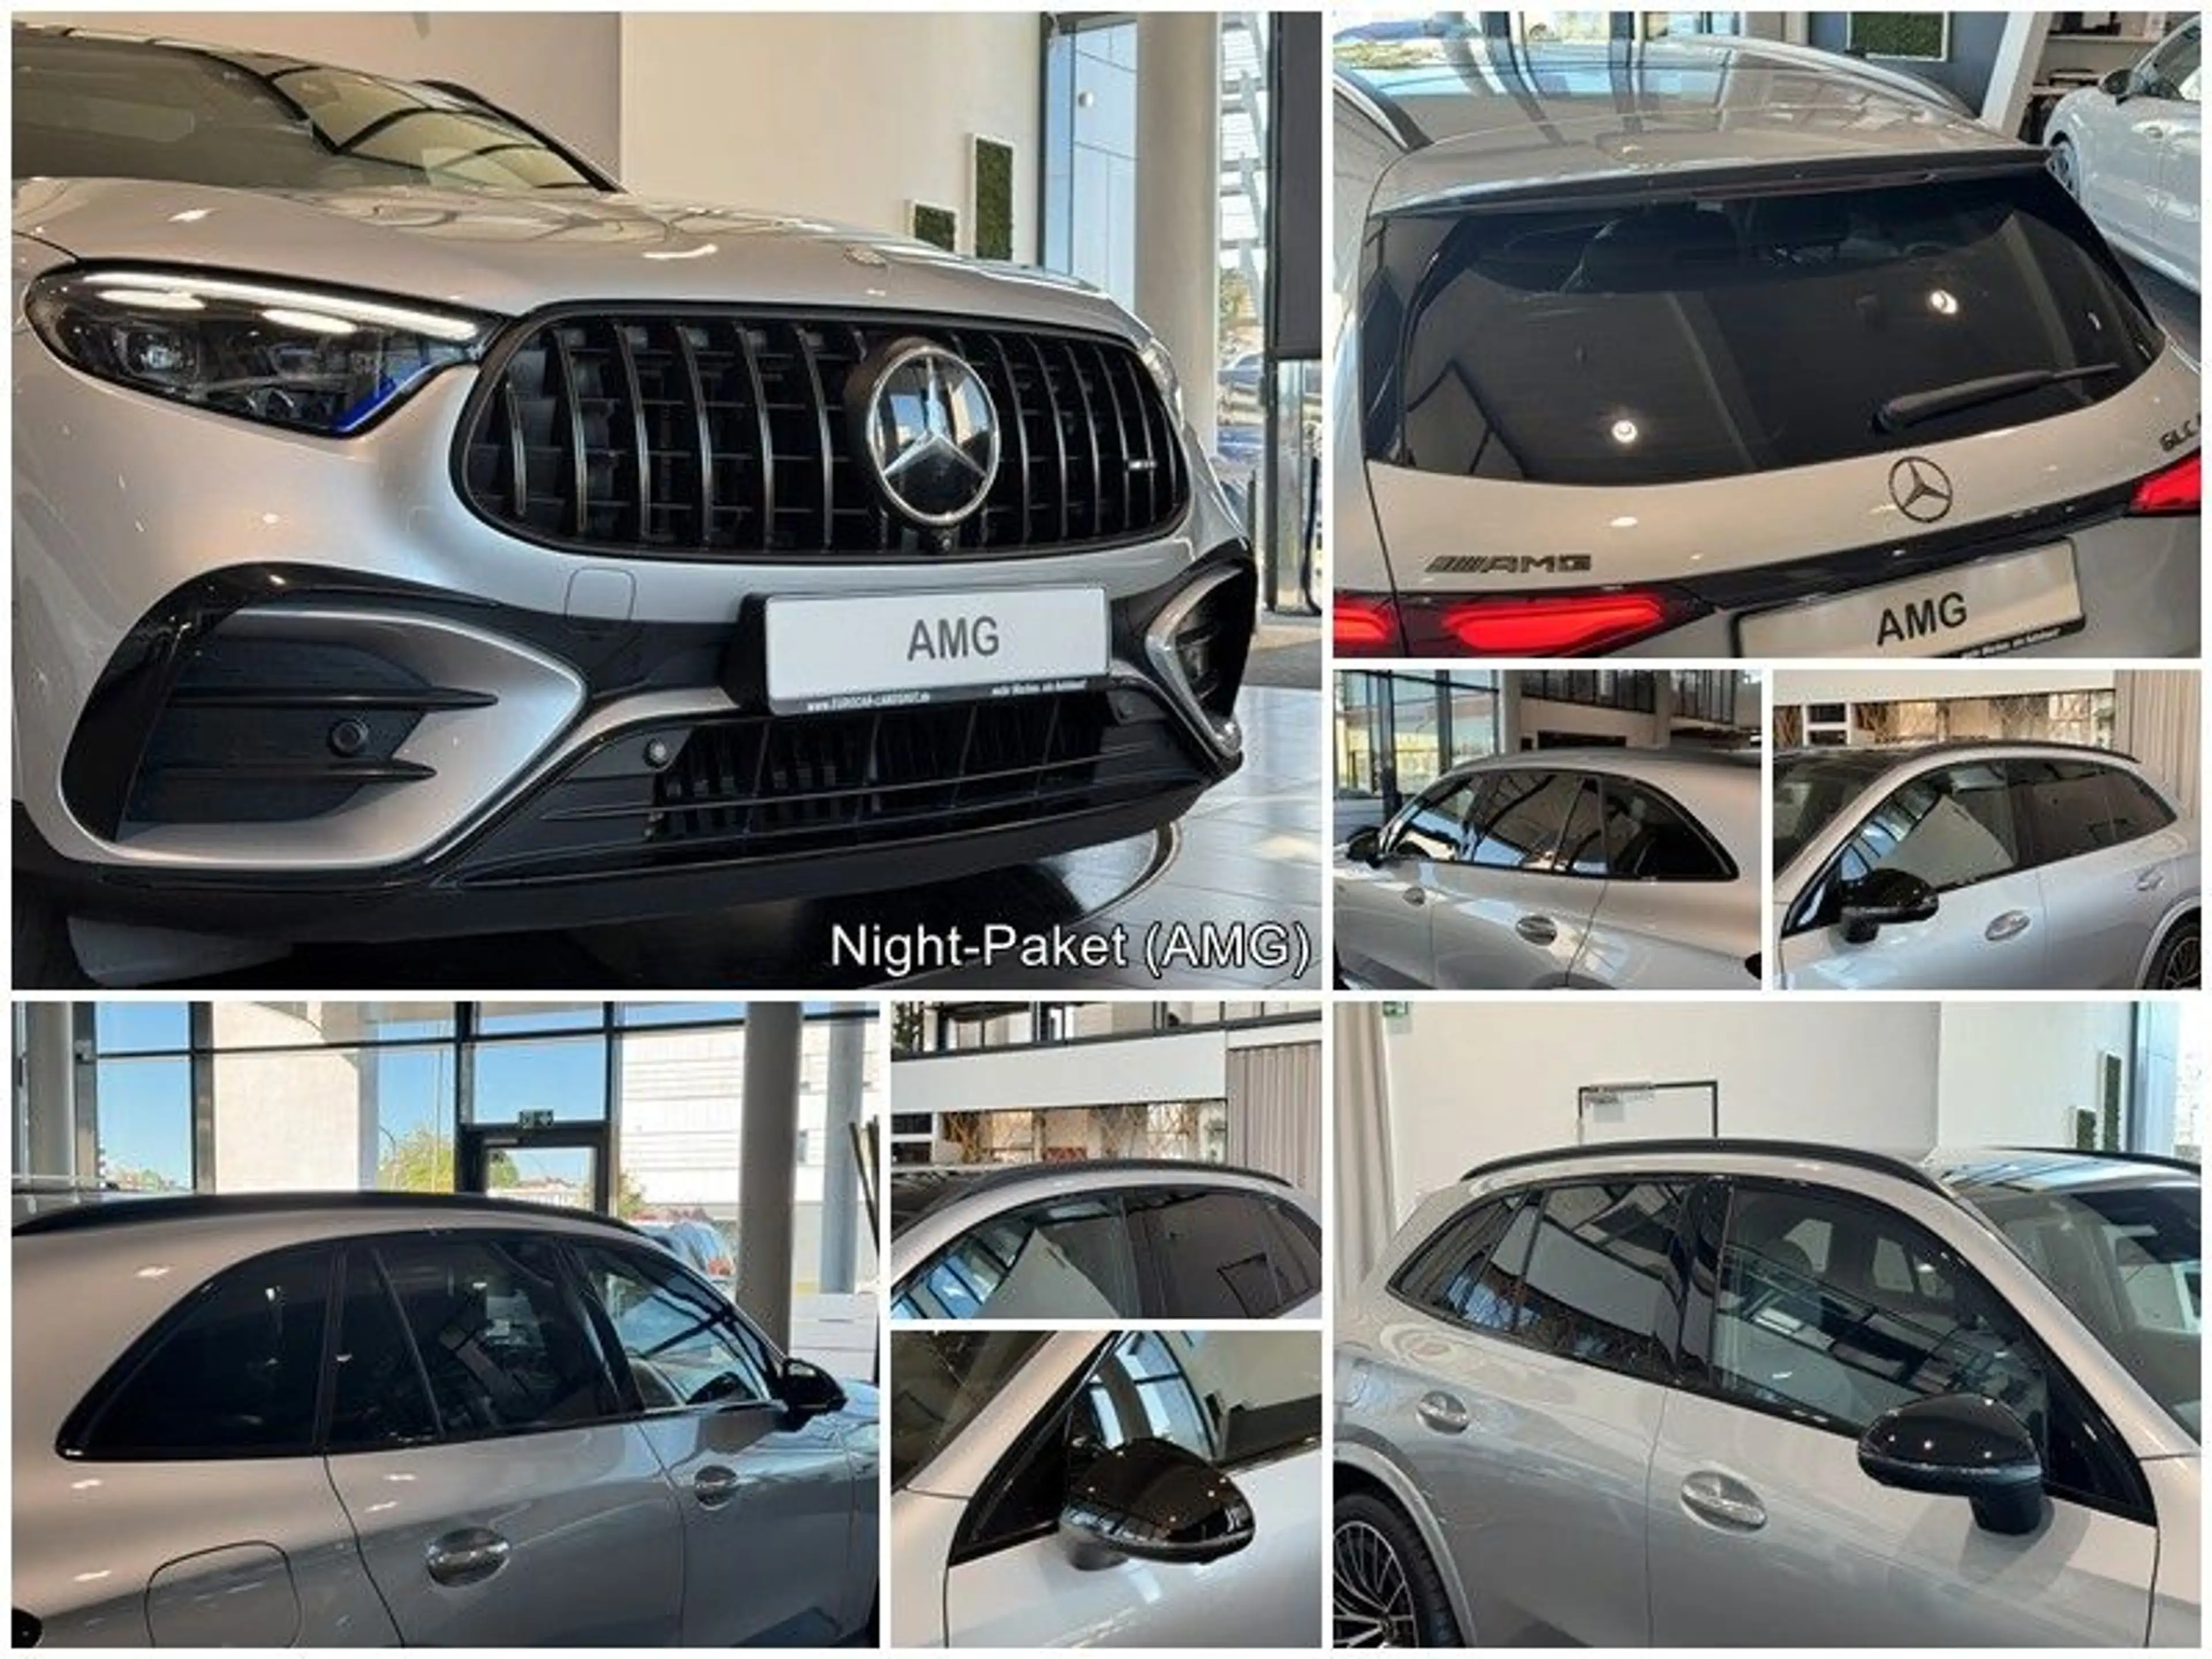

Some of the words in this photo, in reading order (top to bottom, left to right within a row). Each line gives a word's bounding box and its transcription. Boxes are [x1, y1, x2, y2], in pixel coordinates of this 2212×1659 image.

[1479, 554, 1592, 573] AMG
[907, 616, 1000, 661] AMG
[1877, 592, 1968, 646] AMG
